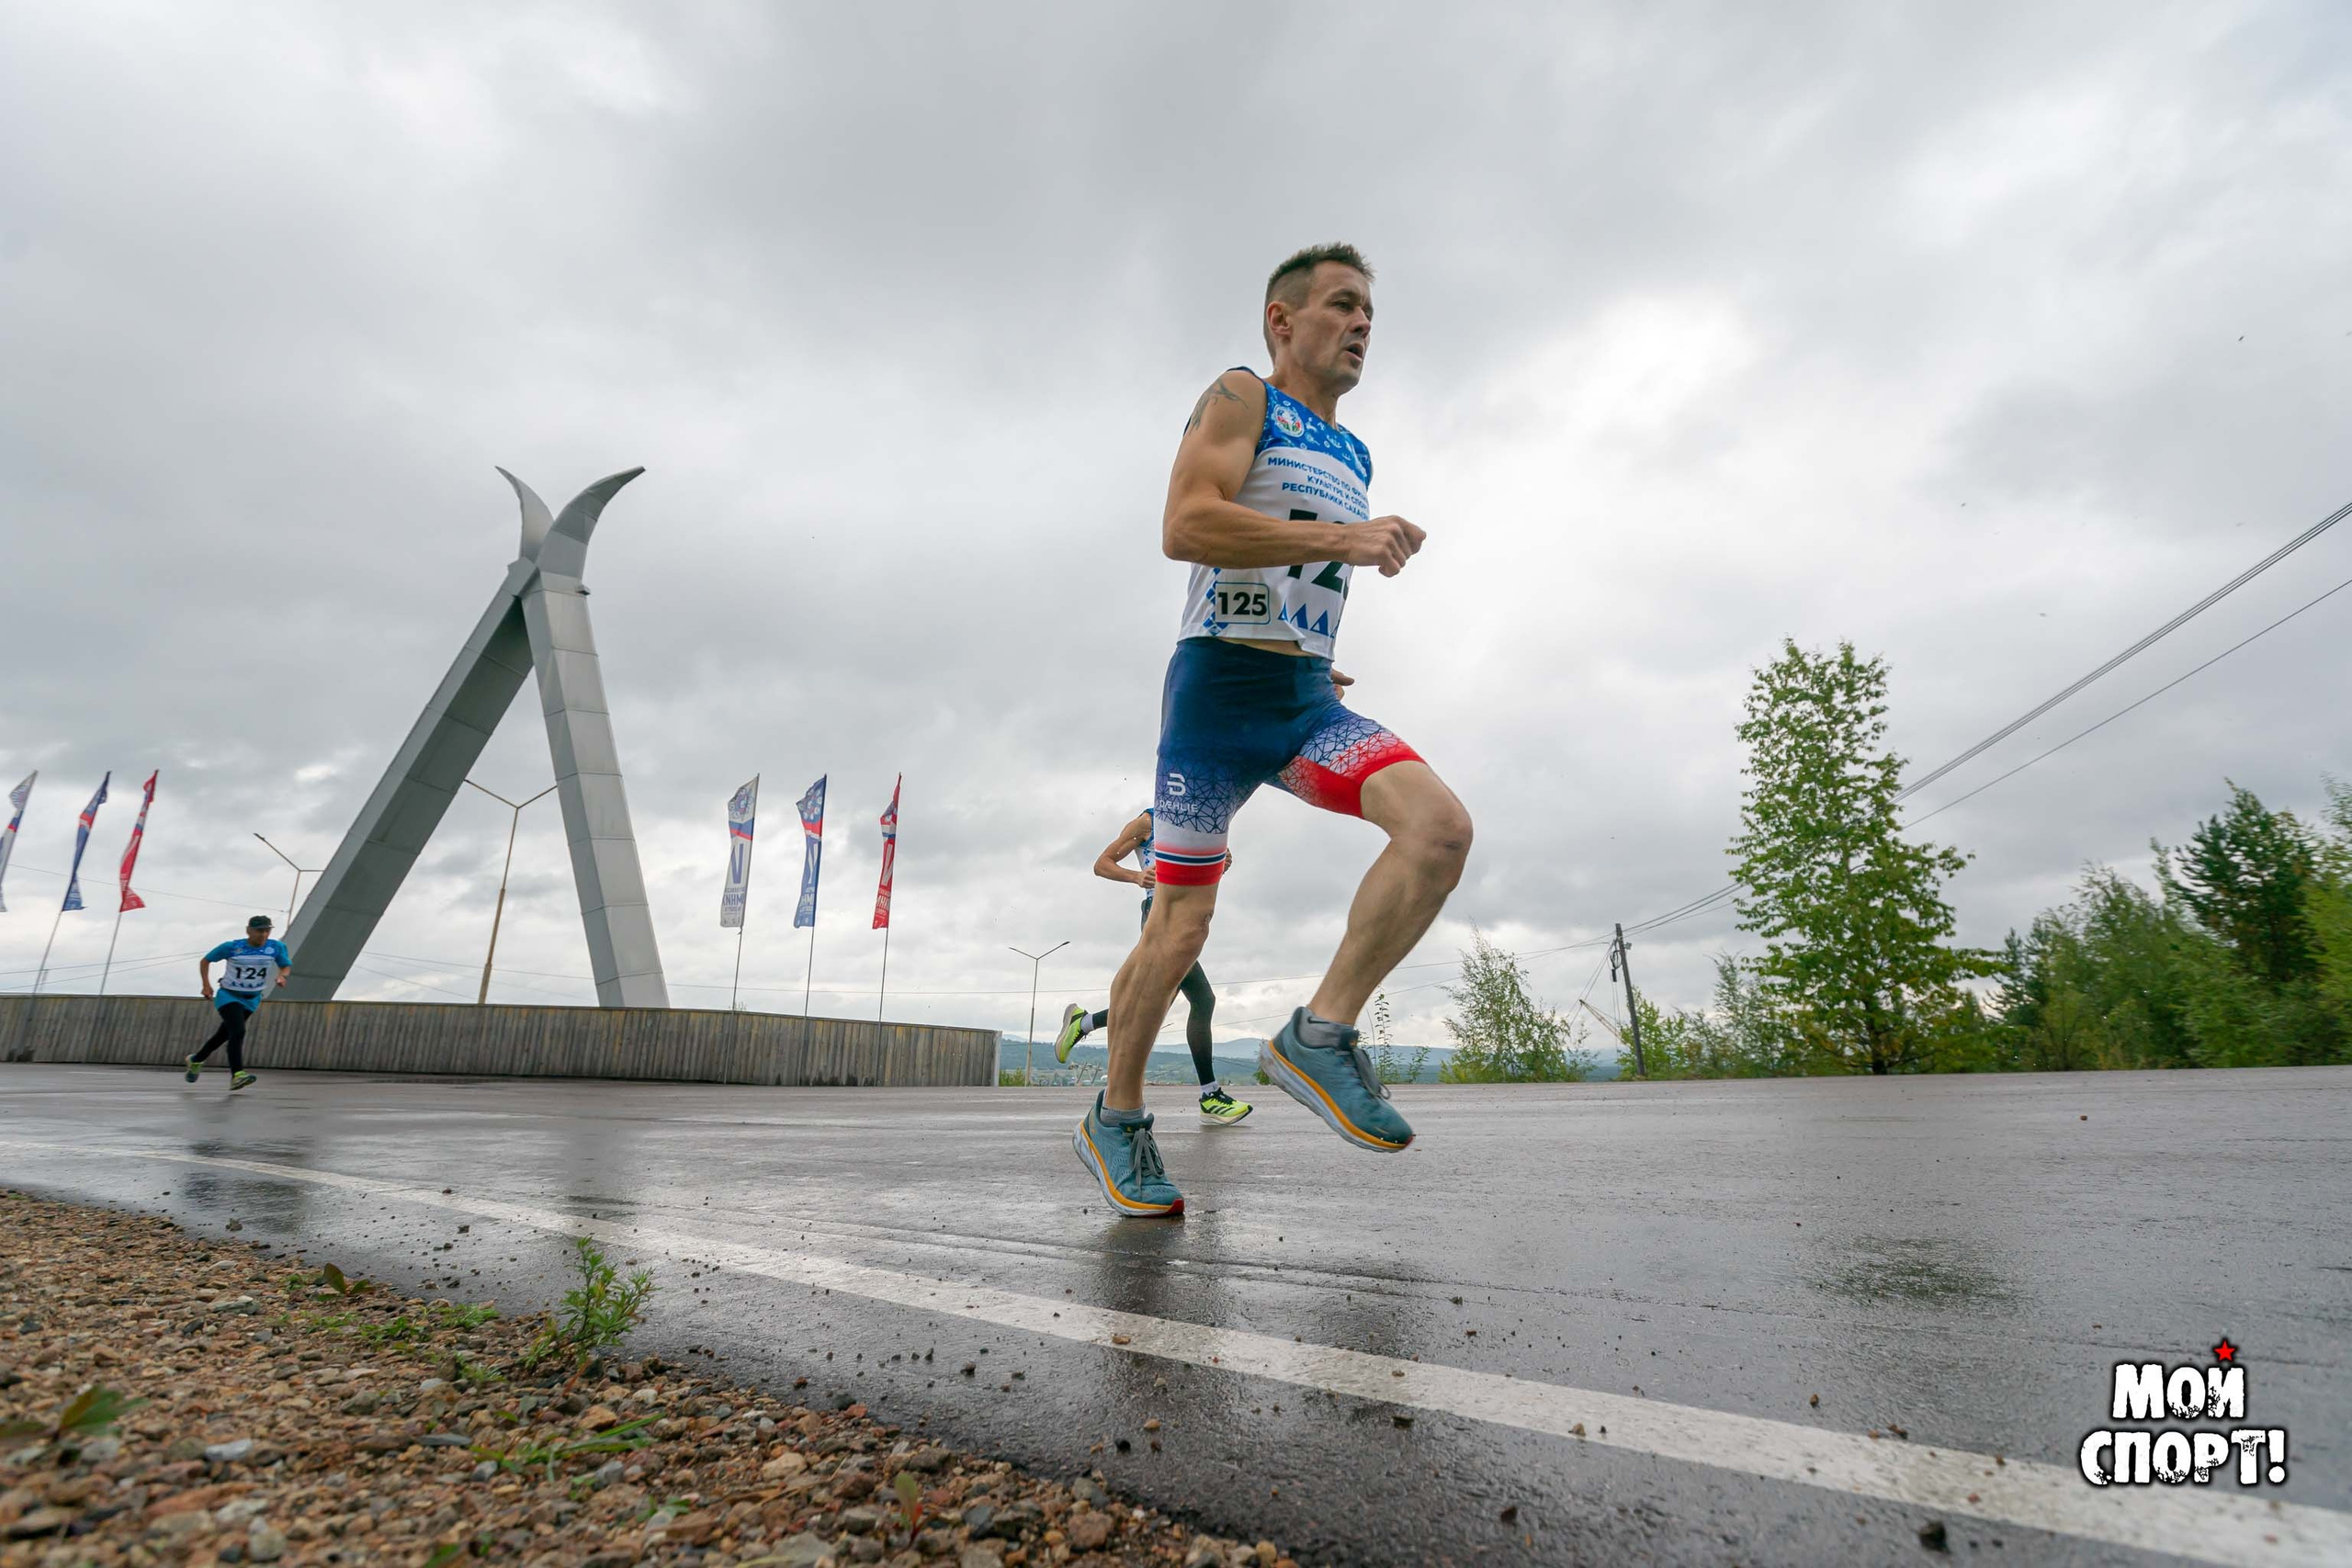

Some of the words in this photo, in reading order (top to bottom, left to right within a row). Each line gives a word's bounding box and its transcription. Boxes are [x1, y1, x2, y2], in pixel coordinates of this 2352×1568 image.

[1268, 457, 1340, 485] МИНИСТЕРСТВО
[1282, 482, 1343, 507] РЕСПУБЛИКИ
[1307, 475, 1344, 498] КУЛЬТУРЕ
[1217, 592, 1267, 616] 125
[235, 967, 267, 980] 124
